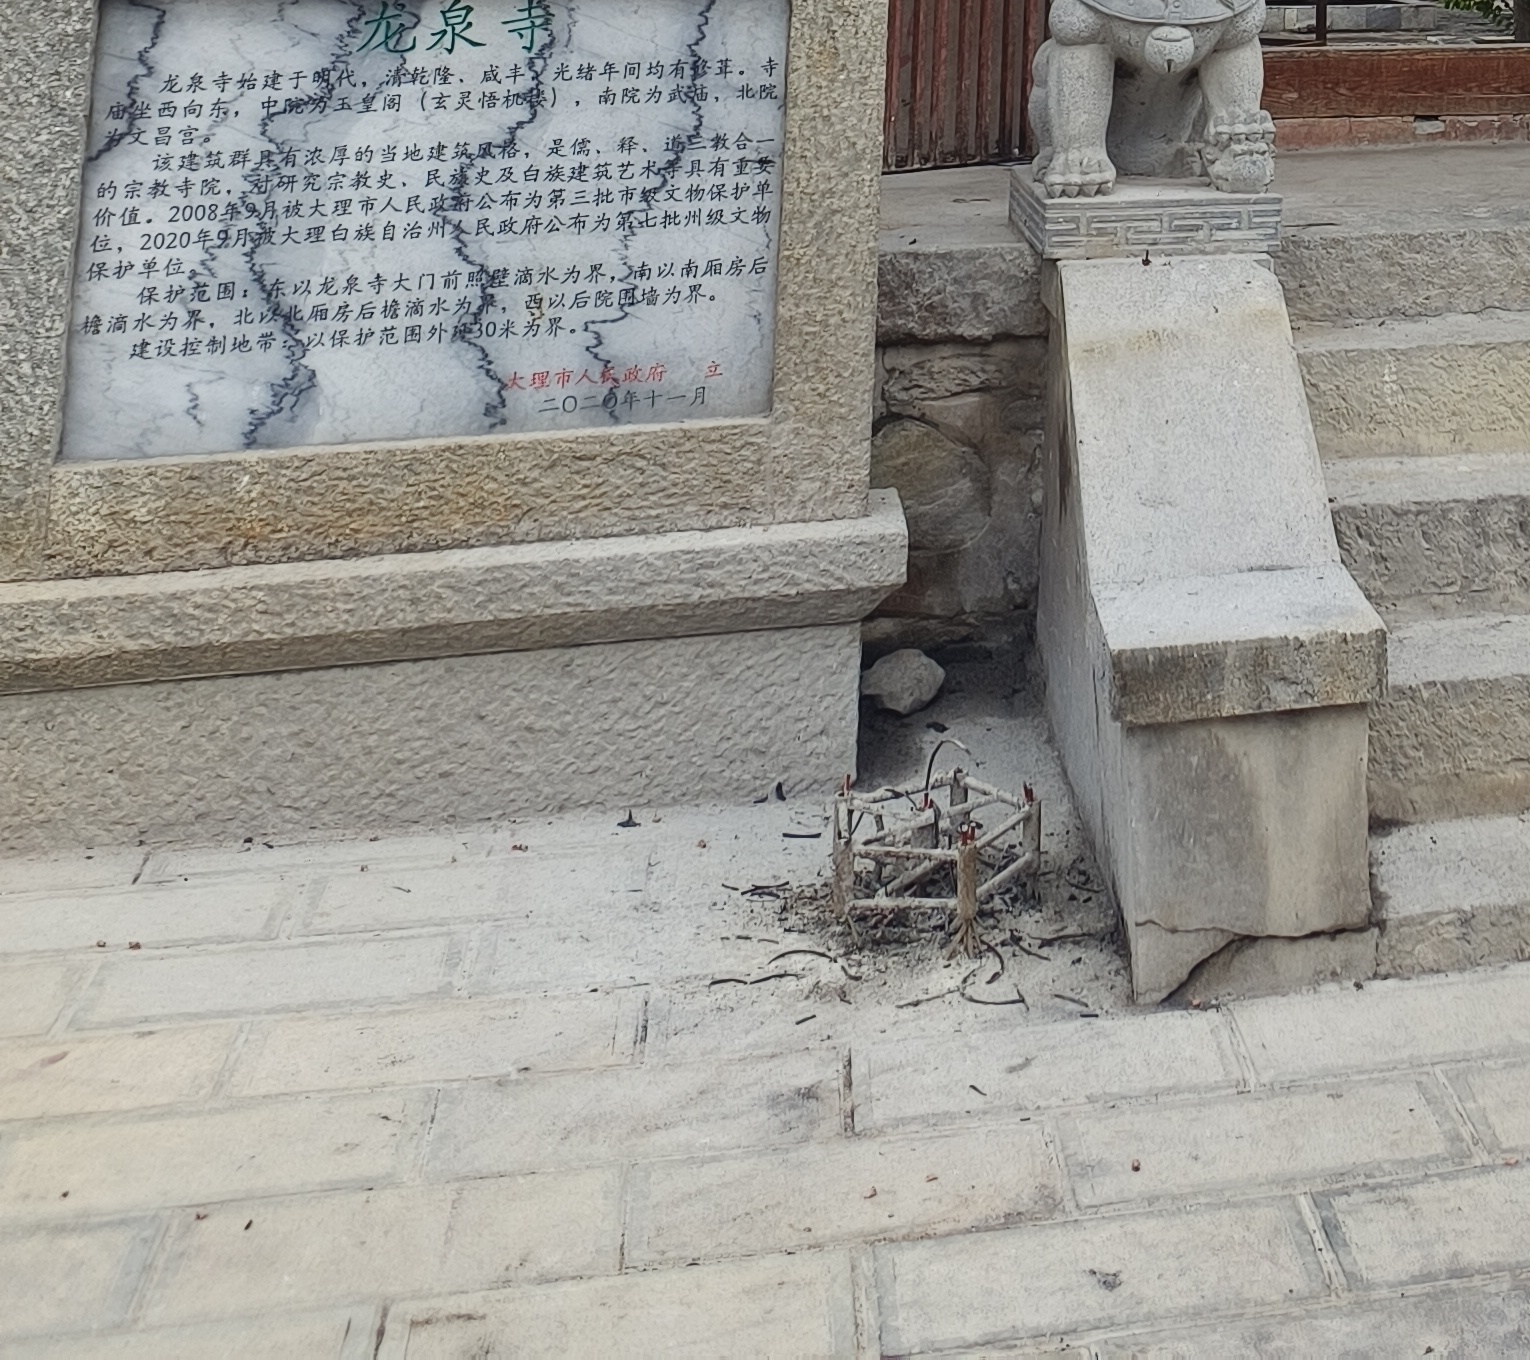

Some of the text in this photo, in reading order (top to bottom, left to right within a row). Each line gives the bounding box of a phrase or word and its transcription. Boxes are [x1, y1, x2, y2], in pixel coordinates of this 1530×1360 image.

[505, 360, 723, 391] 大理市人民政府 立
